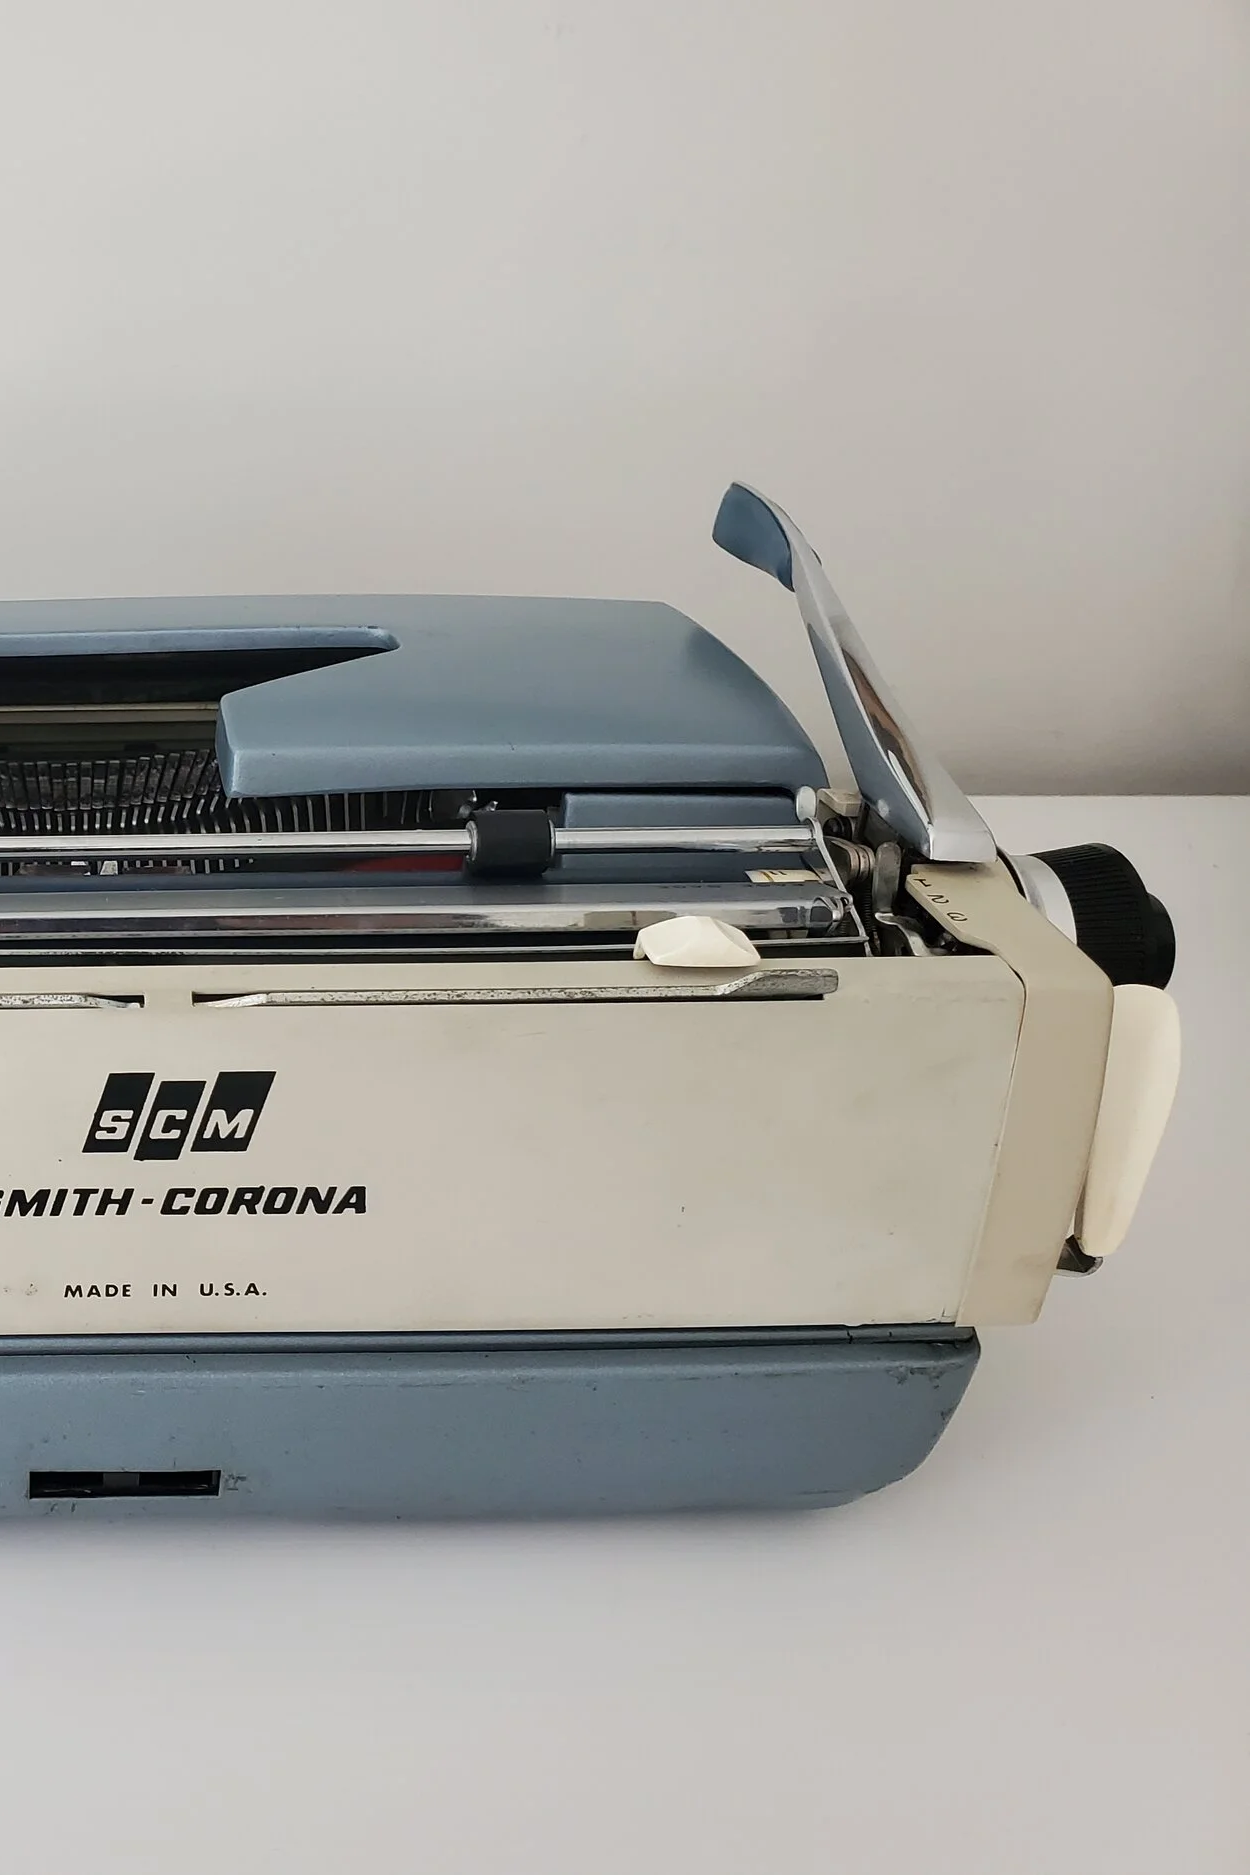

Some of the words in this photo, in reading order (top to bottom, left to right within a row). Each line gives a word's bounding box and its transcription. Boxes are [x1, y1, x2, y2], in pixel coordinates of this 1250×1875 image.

[913, 877, 932, 888] 1
[927, 893, 950, 905] 2
[946, 911, 968, 923] 3
[94, 1108, 255, 1141] SCM
[63, 1284, 132, 1298] MADE
[153, 1283, 177, 1297] IN
[199, 1282, 268, 1297] U.S.A.
